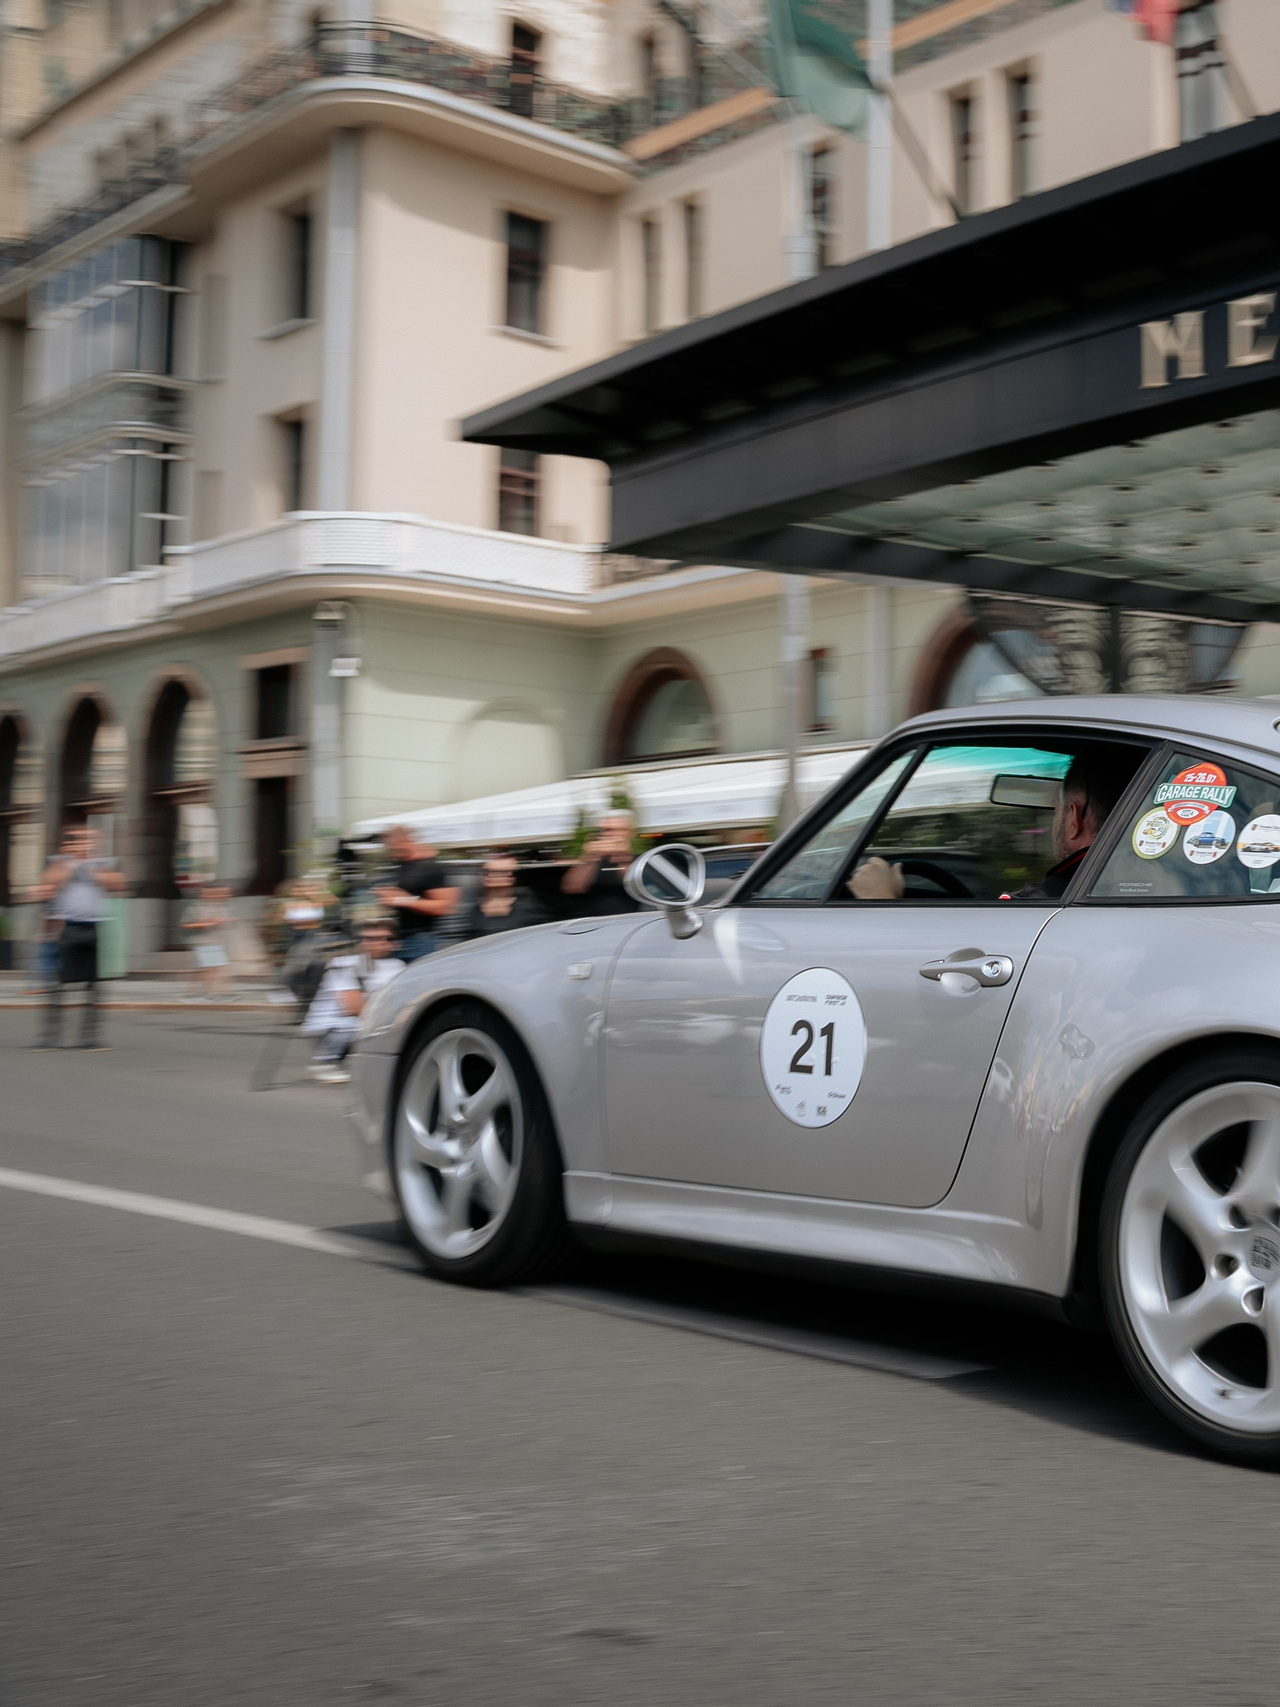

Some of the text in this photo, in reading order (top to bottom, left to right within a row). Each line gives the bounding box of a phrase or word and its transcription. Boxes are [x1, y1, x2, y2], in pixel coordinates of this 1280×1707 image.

[1184, 772, 1217, 783] 25-26.07
[1157, 785, 1201, 802] GARAGE
[1200, 786, 1234, 805] RALLY
[789, 1019, 834, 1076] 21
